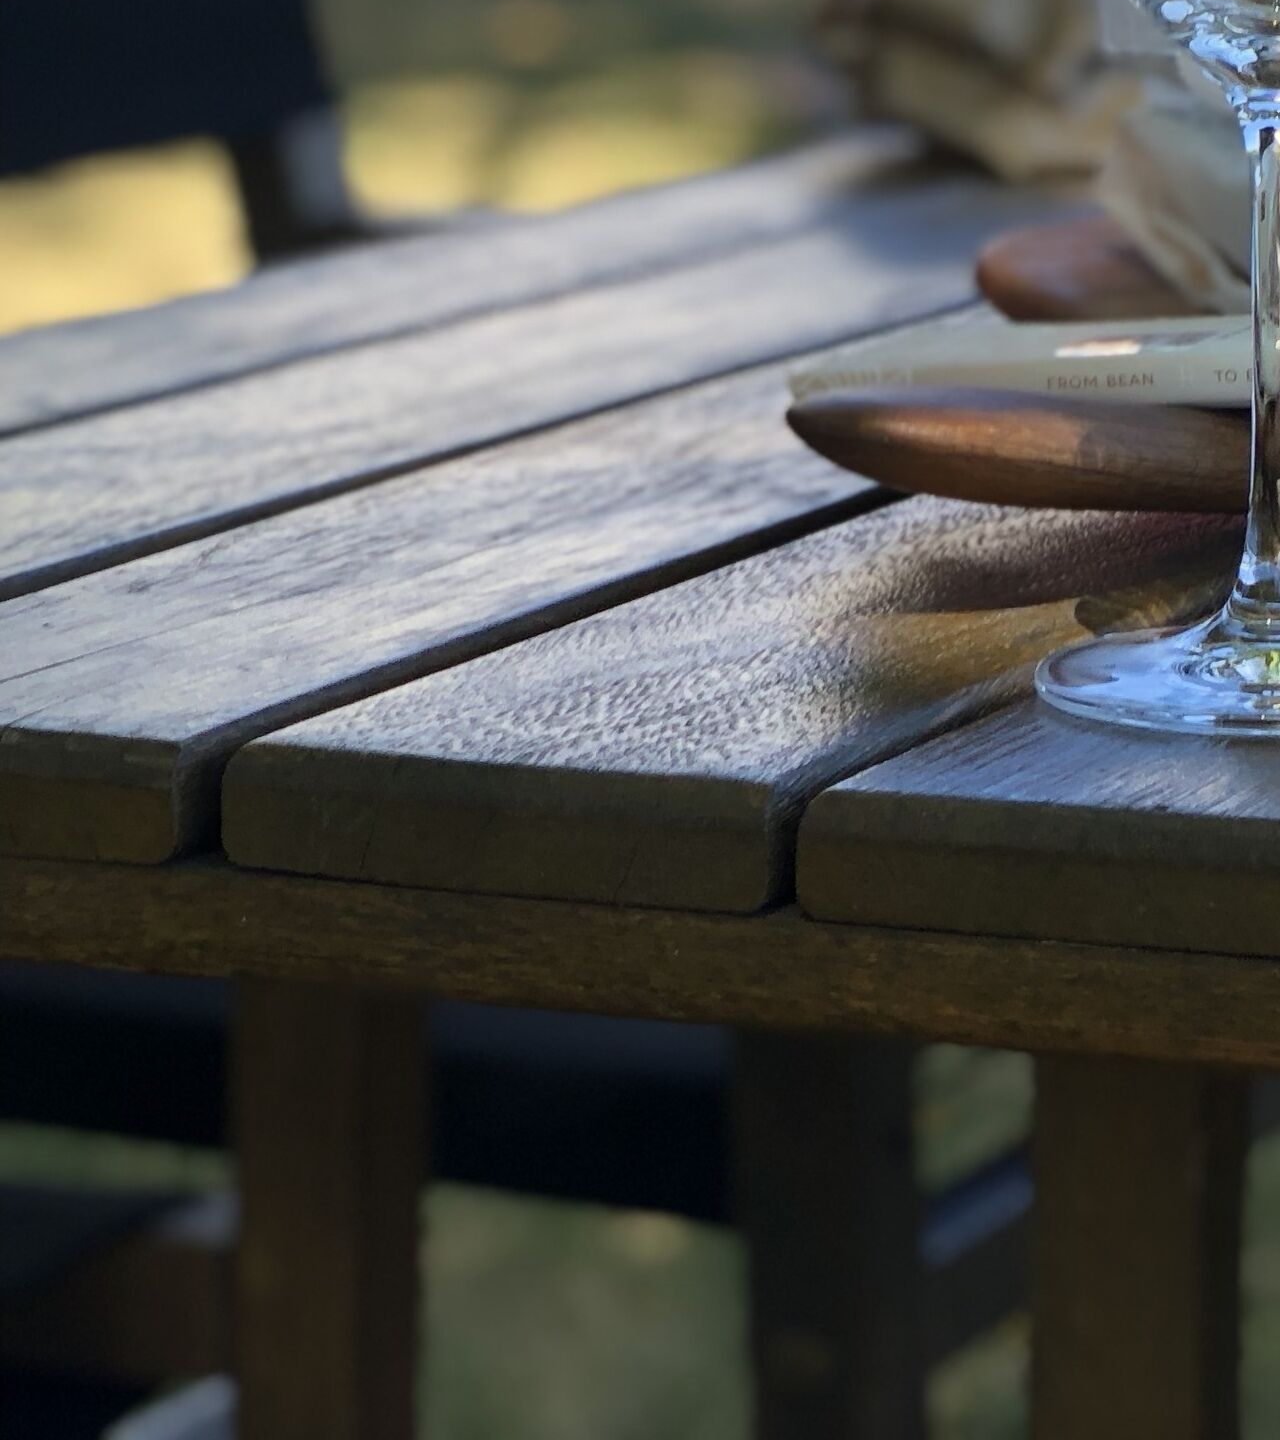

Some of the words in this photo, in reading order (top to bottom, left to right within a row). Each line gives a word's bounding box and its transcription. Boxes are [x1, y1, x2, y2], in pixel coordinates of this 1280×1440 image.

[1046, 375, 1098, 391] FROM
[1105, 372, 1155, 389] BEAN
[1214, 368, 1237, 384] TO
